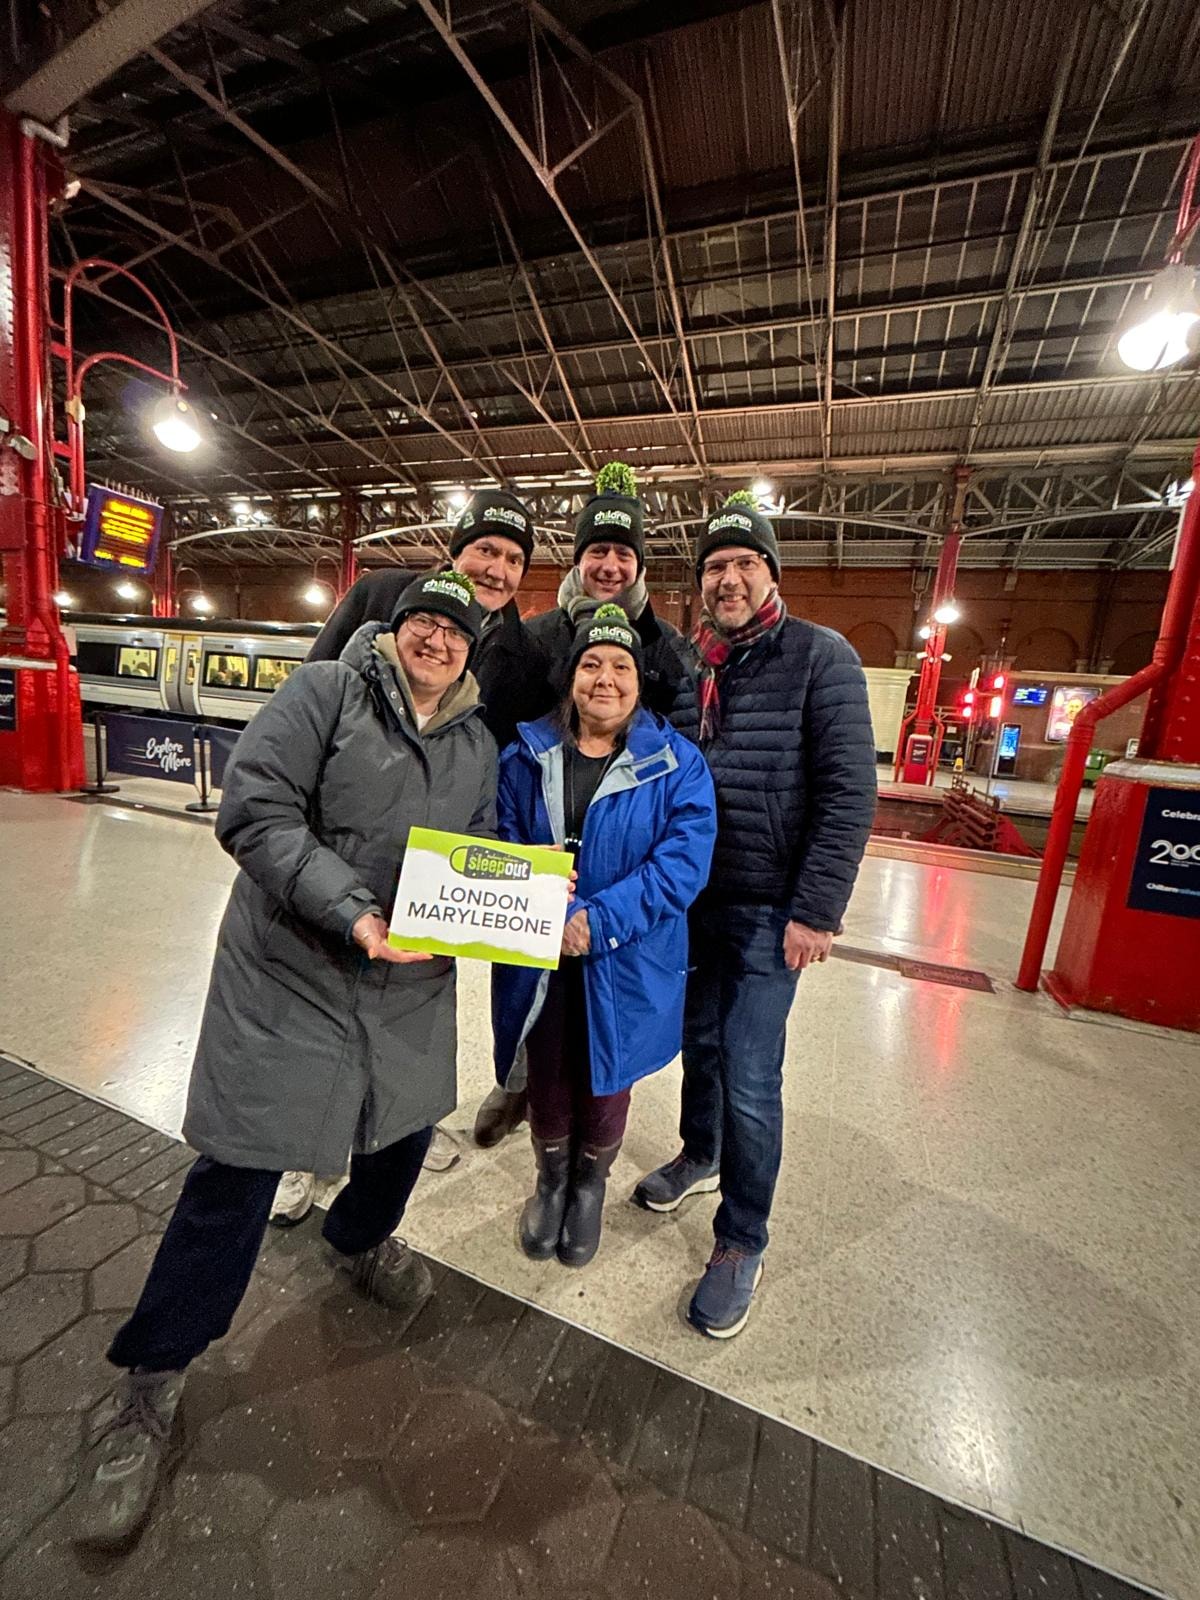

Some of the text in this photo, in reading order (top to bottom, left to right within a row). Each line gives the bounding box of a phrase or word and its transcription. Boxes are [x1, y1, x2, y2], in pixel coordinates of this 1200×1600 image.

[146, 736, 184, 760] Explore
[160, 751, 192, 773] More
[468, 853, 529, 878] sleepout
[439, 885, 529, 912] LONDON
[407, 901, 552, 936] MARYLEBONE
